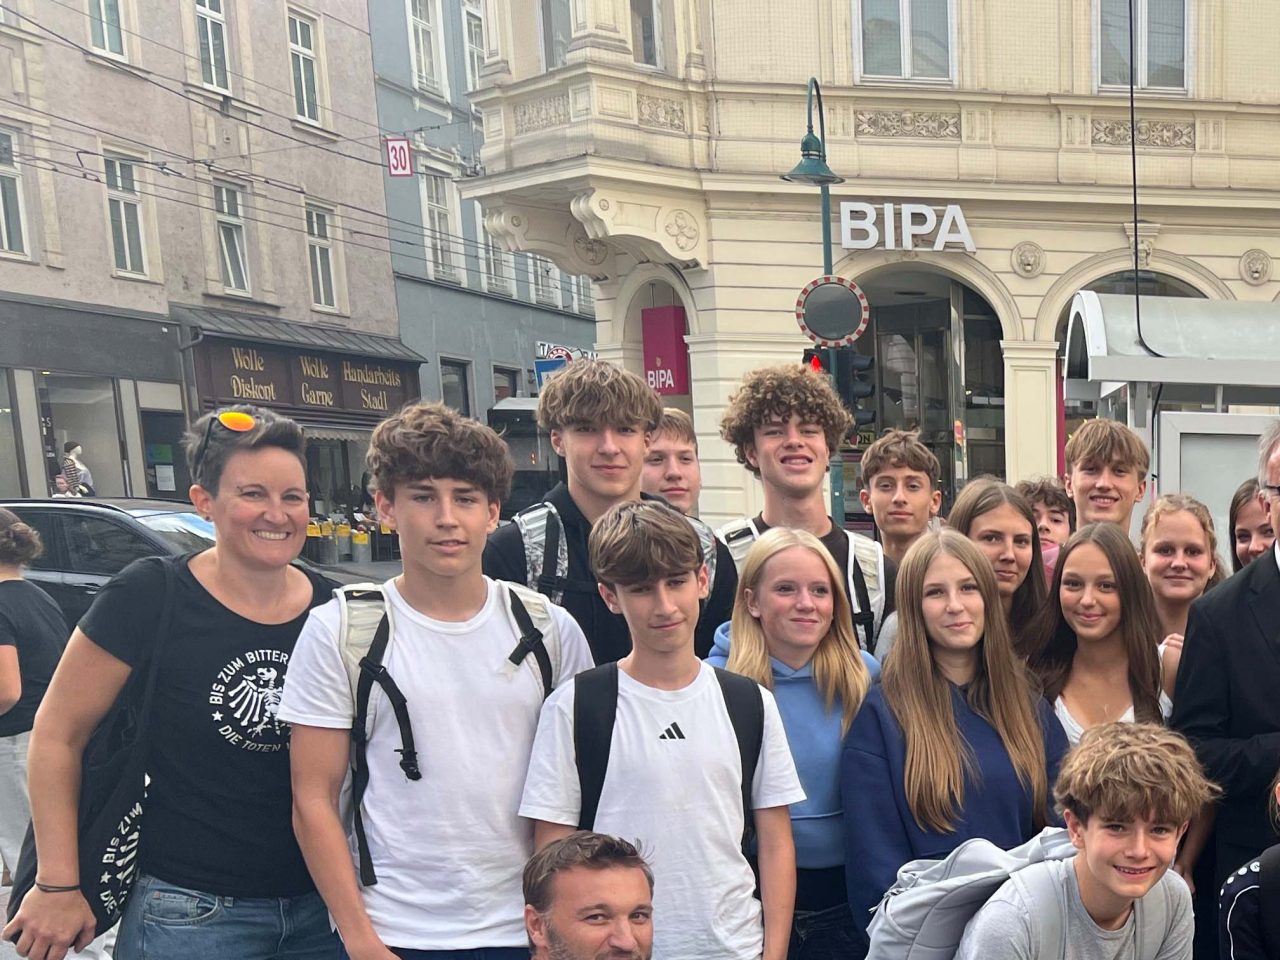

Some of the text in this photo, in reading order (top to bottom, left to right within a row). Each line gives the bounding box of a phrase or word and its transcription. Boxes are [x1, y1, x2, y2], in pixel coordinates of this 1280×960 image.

[391, 145, 407, 171] 30
[840, 202, 977, 252] BIPA
[231, 347, 264, 371] Wolle
[300, 356, 329, 378] Wolle
[343, 361, 400, 387] Handarbeits
[647, 369, 674, 388] BIPA
[231, 375, 276, 401] Diskont
[301, 382, 333, 407] Garne
[360, 389, 388, 410] Stadl
[209, 649, 289, 704] BIS ZUM BITTER
[218, 725, 243, 745] DIE
[241, 740, 281, 752] TOTEN
[102, 837, 120, 864] BIS
[100, 890, 117, 915] DIE
